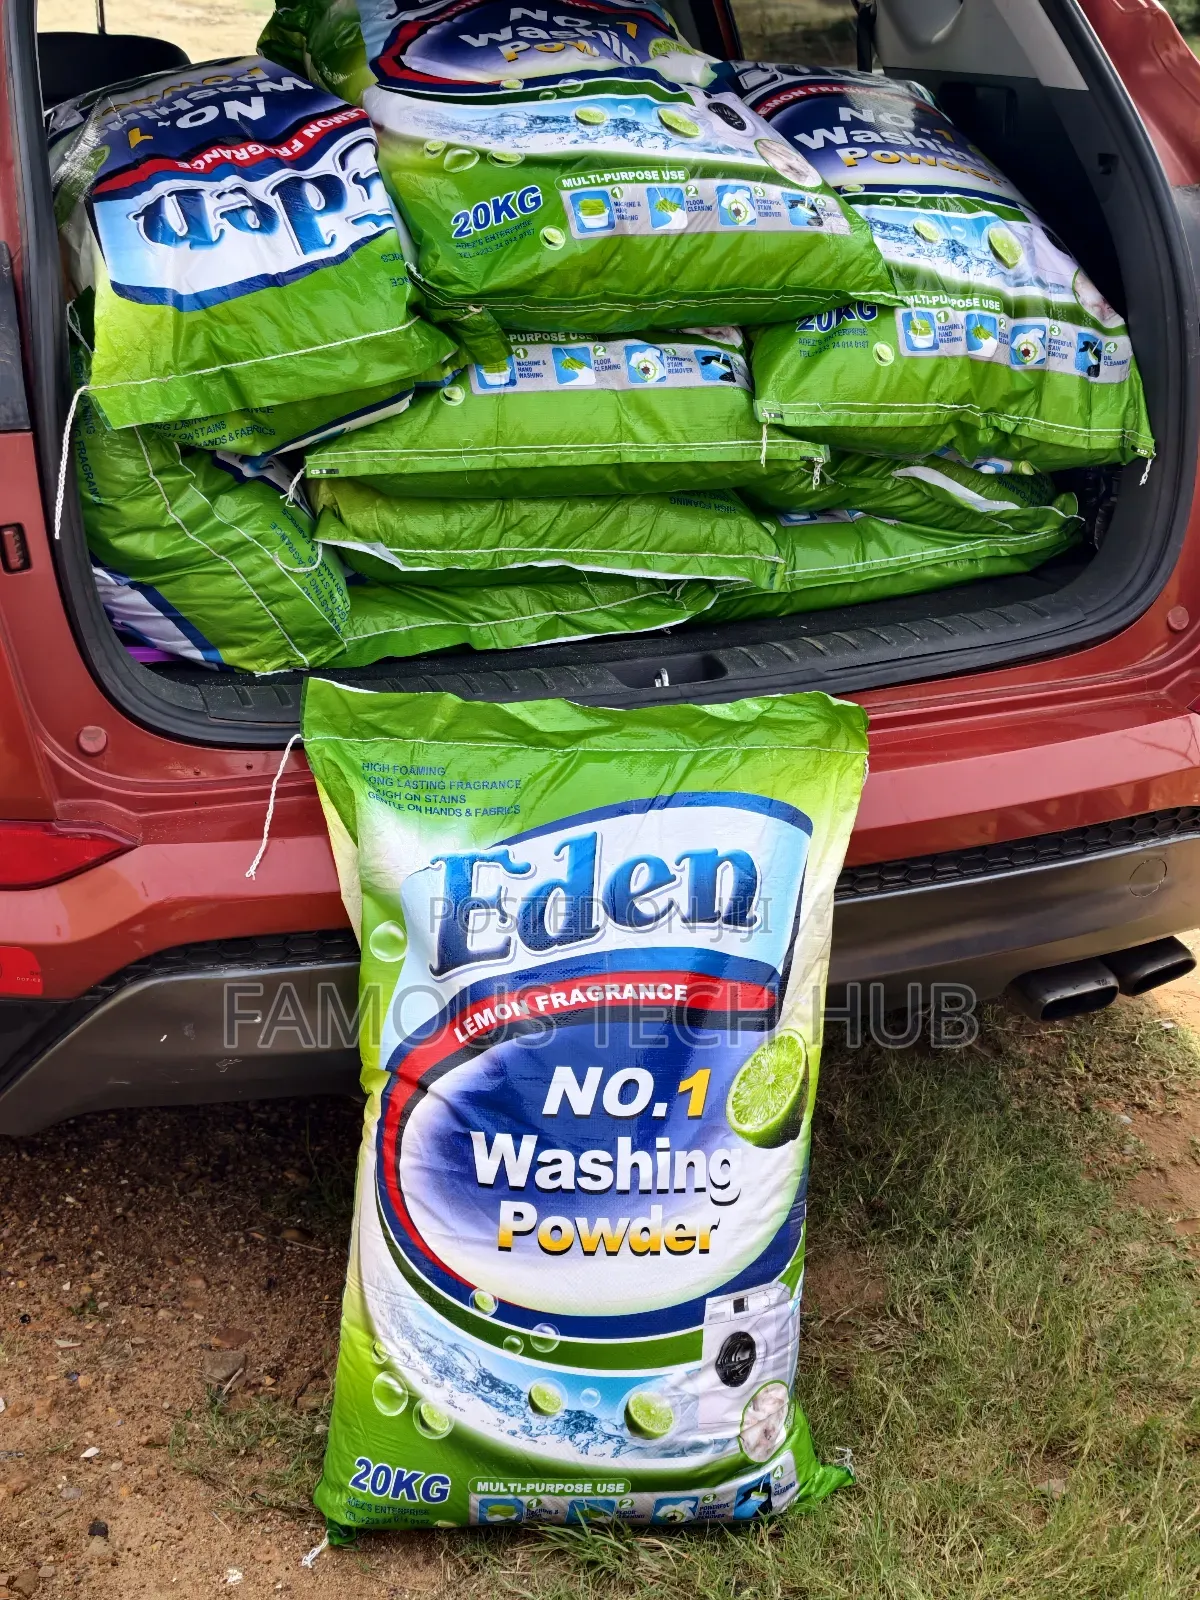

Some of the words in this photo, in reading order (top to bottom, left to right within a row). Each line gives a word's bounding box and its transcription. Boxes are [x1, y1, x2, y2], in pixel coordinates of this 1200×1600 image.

[458, 25, 642, 66] Washin
[500, 39, 600, 63] Pow
[758, 89, 807, 117] EMON
[302, 108, 368, 138] LEMON
[175, 138, 305, 170] FRAGRANCE
[562, 170, 660, 188] MULTI-PURPOSE
[663, 170, 686, 180] USE
[687, 185, 697, 197] 2
[451, 184, 543, 239] 20KG
[484, 220, 533, 243] ENTERPRISE
[381, 252, 404, 263] RICS
[982, 298, 1000, 311] USE
[507, 332, 566, 343] -PURPOSE
[595, 345, 605, 357] 2
[1105, 342, 1116, 353] 4
[1048, 351, 1069, 360] EMOVER
[594, 364, 621, 372] CLEANING
[149, 422, 171, 431] ONG
[194, 420, 227, 438] STAINS
[235, 424, 276, 440] FABRICS
[75, 441, 102, 504] FRAGRANC
[270, 521, 313, 579] FAGRANCE
[362, 762, 390, 773] HIGH
[393, 764, 446, 776] FOAMING
[397, 778, 446, 790] LASTING
[449, 779, 522, 791] FRAGRANCE
[367, 791, 405, 812] GENTLE
[407, 803, 423, 813] ON
[424, 807, 462, 818] HANDS
[464, 808, 473, 817] &
[474, 804, 521, 818] FABRICS
[404, 792, 421, 802] ON
[424, 794, 466, 804] STAINS
[427, 830, 761, 978] Eden
[453, 998, 530, 1044] LEMON
[536, 983, 689, 1016] FRAGRANCE
[469, 1130, 742, 1206] Washing
[497, 1200, 720, 1256] Powder
[350, 1456, 451, 1504] 20KG
[773, 1466, 783, 1479] 4
[476, 1481, 592, 1495] MULTI-PURPOSE
[596, 1482, 625, 1493] USE
[620, 1498, 632, 1509] 2
[703, 1493, 714, 1503] 3
[374, 1505, 430, 1516] ENTERPRISE
[699, 1502, 730, 1511] POWERFUL
